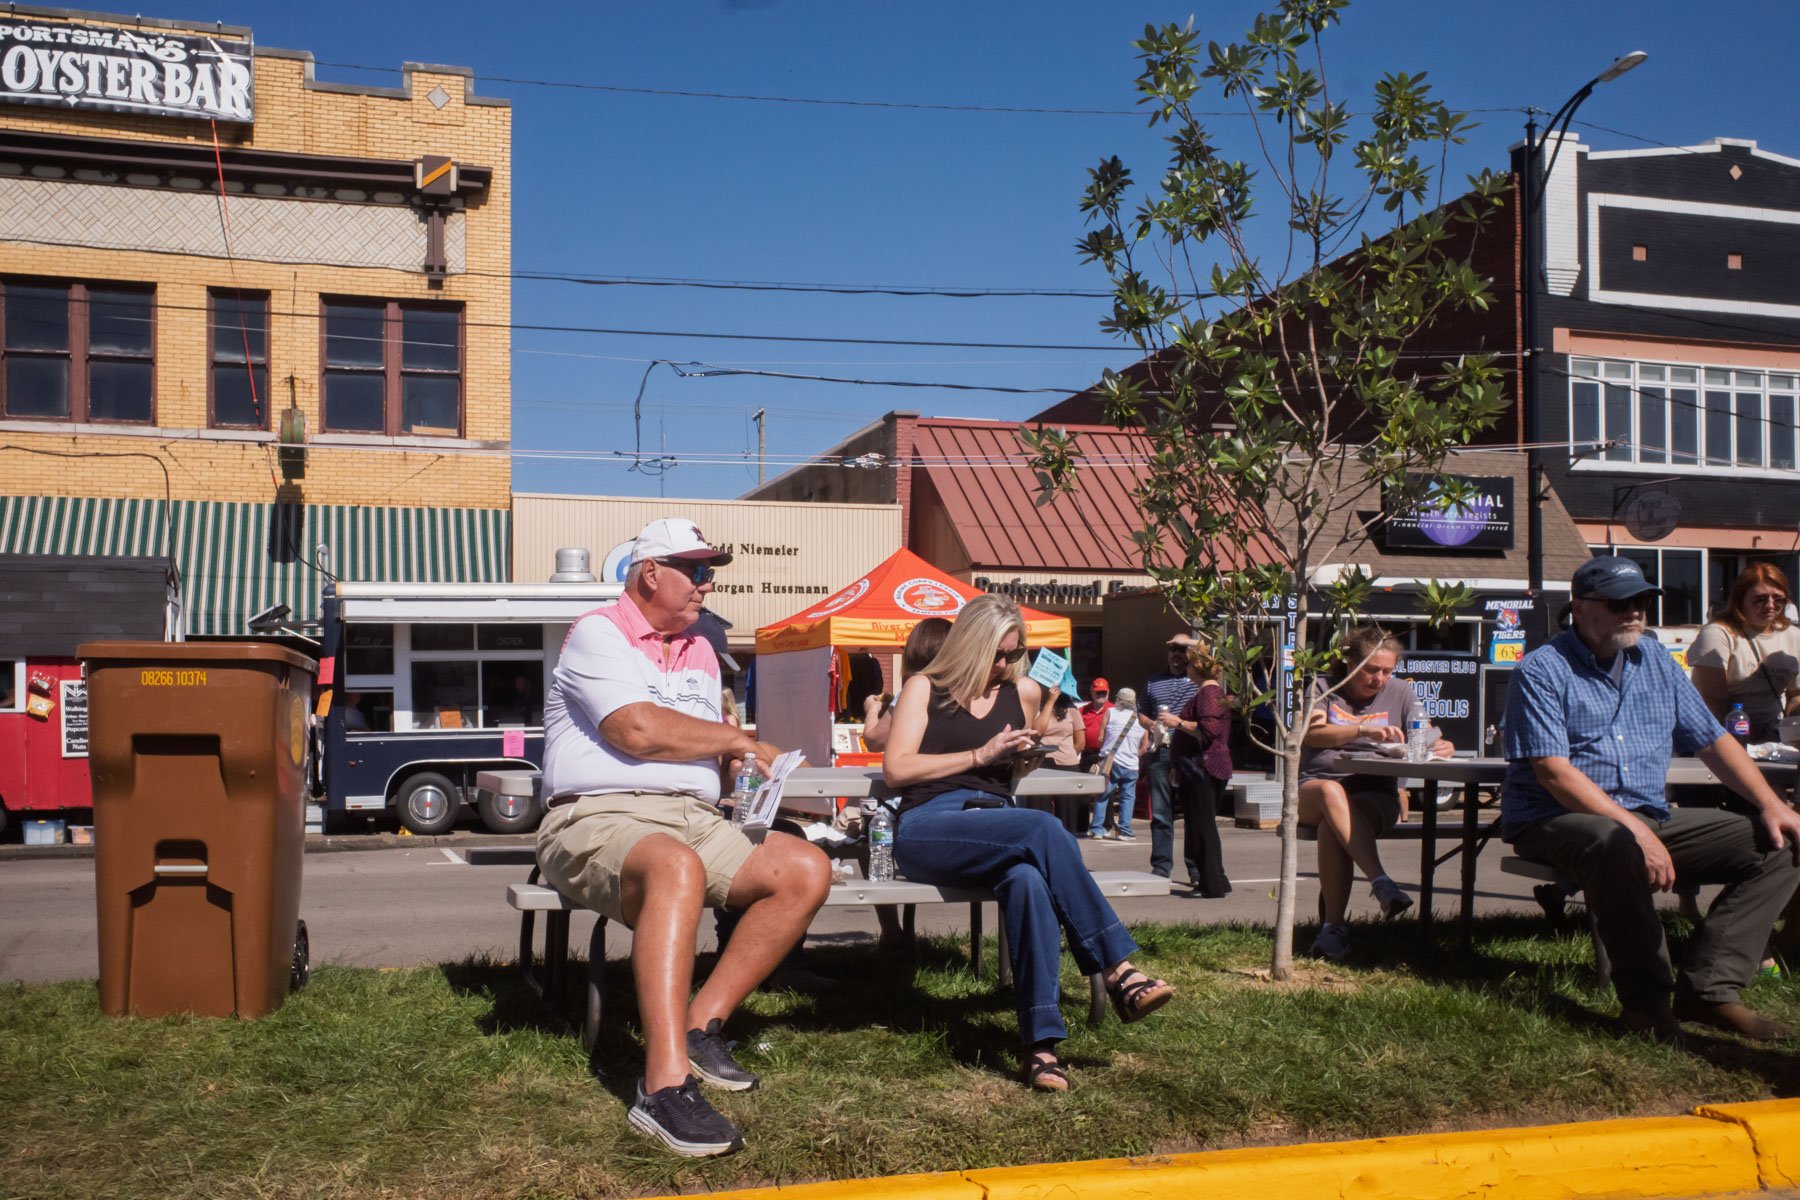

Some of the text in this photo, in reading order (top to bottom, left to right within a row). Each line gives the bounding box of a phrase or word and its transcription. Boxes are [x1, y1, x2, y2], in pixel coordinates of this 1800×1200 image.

[162, 61, 252, 119] BAR
[740, 544, 799, 556] Niemeier
[761, 582, 829, 595] Hussmann
[1485, 600, 1534, 610] MEMORIAL
[1492, 630, 1526, 640] TIGERS
[1407, 660, 1449, 673] BOOSTER
[1451, 660, 1476, 674] CLUB
[141, 671, 207, 686] 08266 10374
